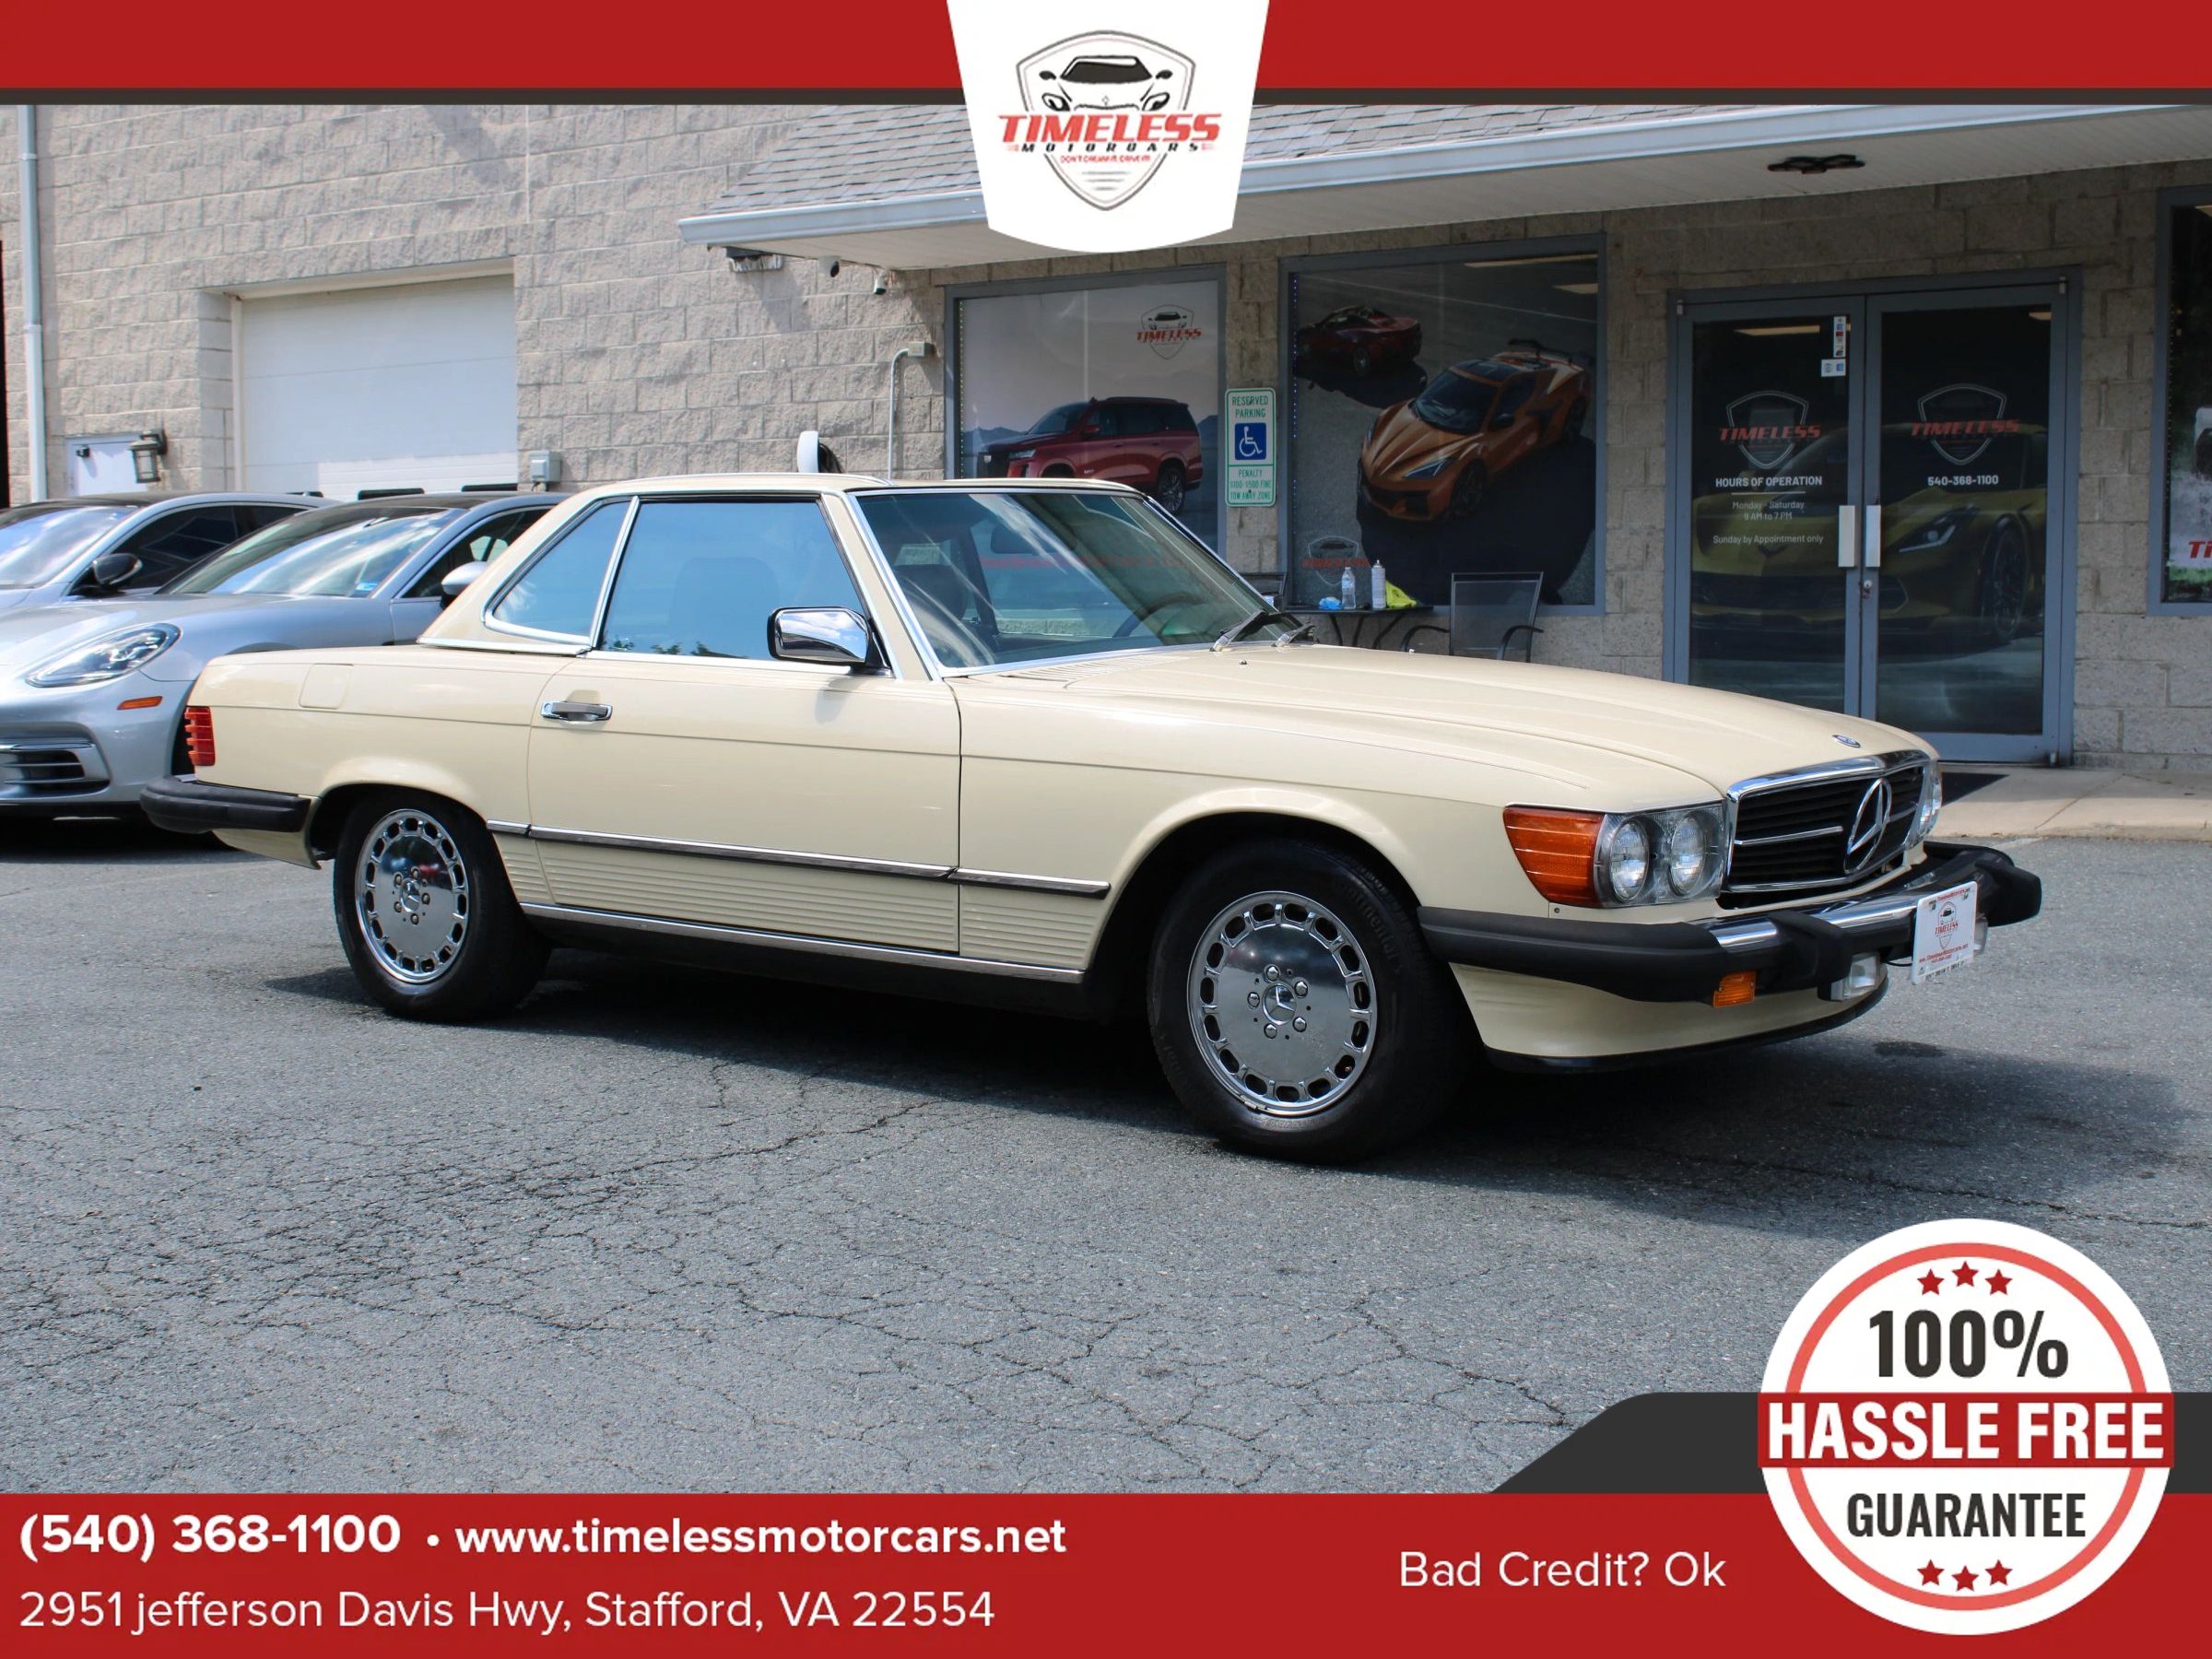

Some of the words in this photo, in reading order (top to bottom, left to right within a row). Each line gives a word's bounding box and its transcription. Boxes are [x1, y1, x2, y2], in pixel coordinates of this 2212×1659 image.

[1232, 395, 1268, 406] RESERVED
[1235, 408, 1265, 418] PARKING
[1719, 425, 1821, 441] TIMELESS
[1910, 420, 2020, 436] TIMELESS
[1238, 469, 1263, 477] PENALTY
[1715, 477, 1748, 488] HOURS
[1751, 477, 1764, 487] OF
[1765, 476, 1823, 487] OPERATION
[1927, 475, 1999, 487] 540-368-1100
[1732, 501, 1763, 511] Monday
[1769, 500, 1805, 511] Saturday
[1750, 512, 1763, 521] AM
[1764, 512, 1773, 521] to
[1780, 512, 1793, 520] PM
[1712, 535, 1743, 546] Sunday
[1743, 535, 1753, 546] by
[1754, 535, 1806, 546] Appointment
[1806, 535, 1824, 545] only
